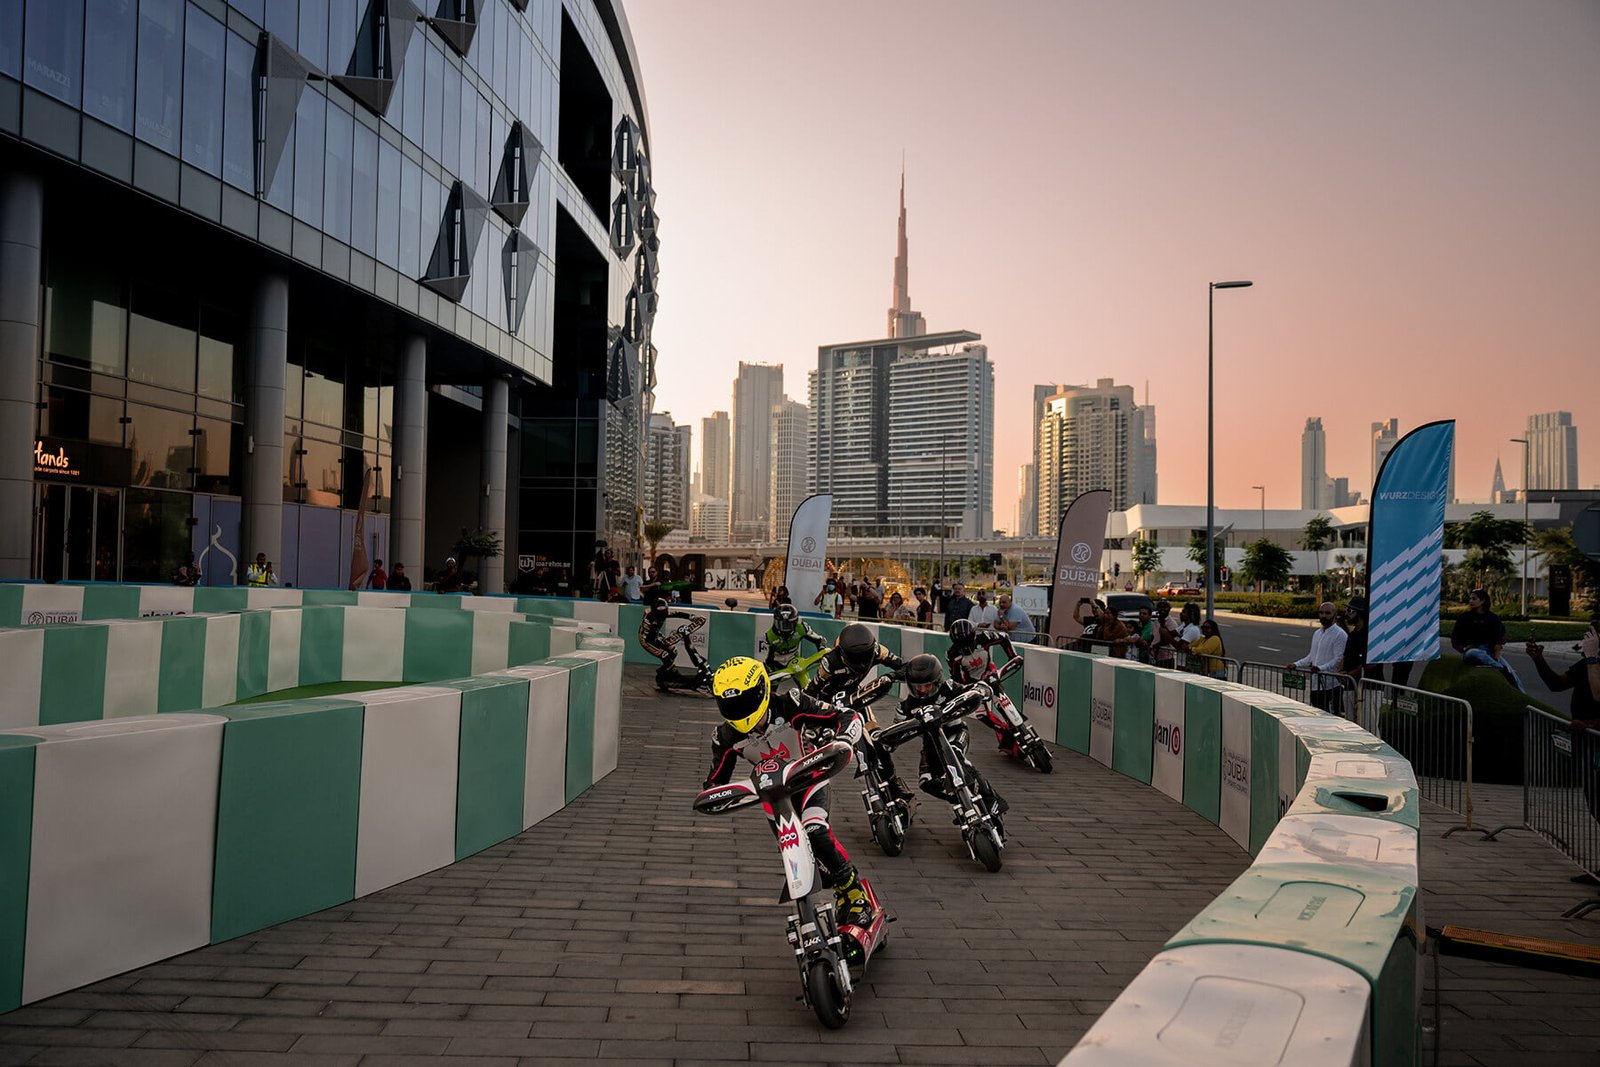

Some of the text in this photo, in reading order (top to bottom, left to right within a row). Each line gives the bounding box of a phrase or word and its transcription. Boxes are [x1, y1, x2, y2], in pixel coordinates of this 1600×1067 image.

[27, 57, 71, 88] MARAZZI
[791, 558, 822, 569] DUBAI
[1060, 568, 1098, 584] DUBAI
[756, 759, 780, 777] 16
[708, 789, 733, 801] XPLOR
